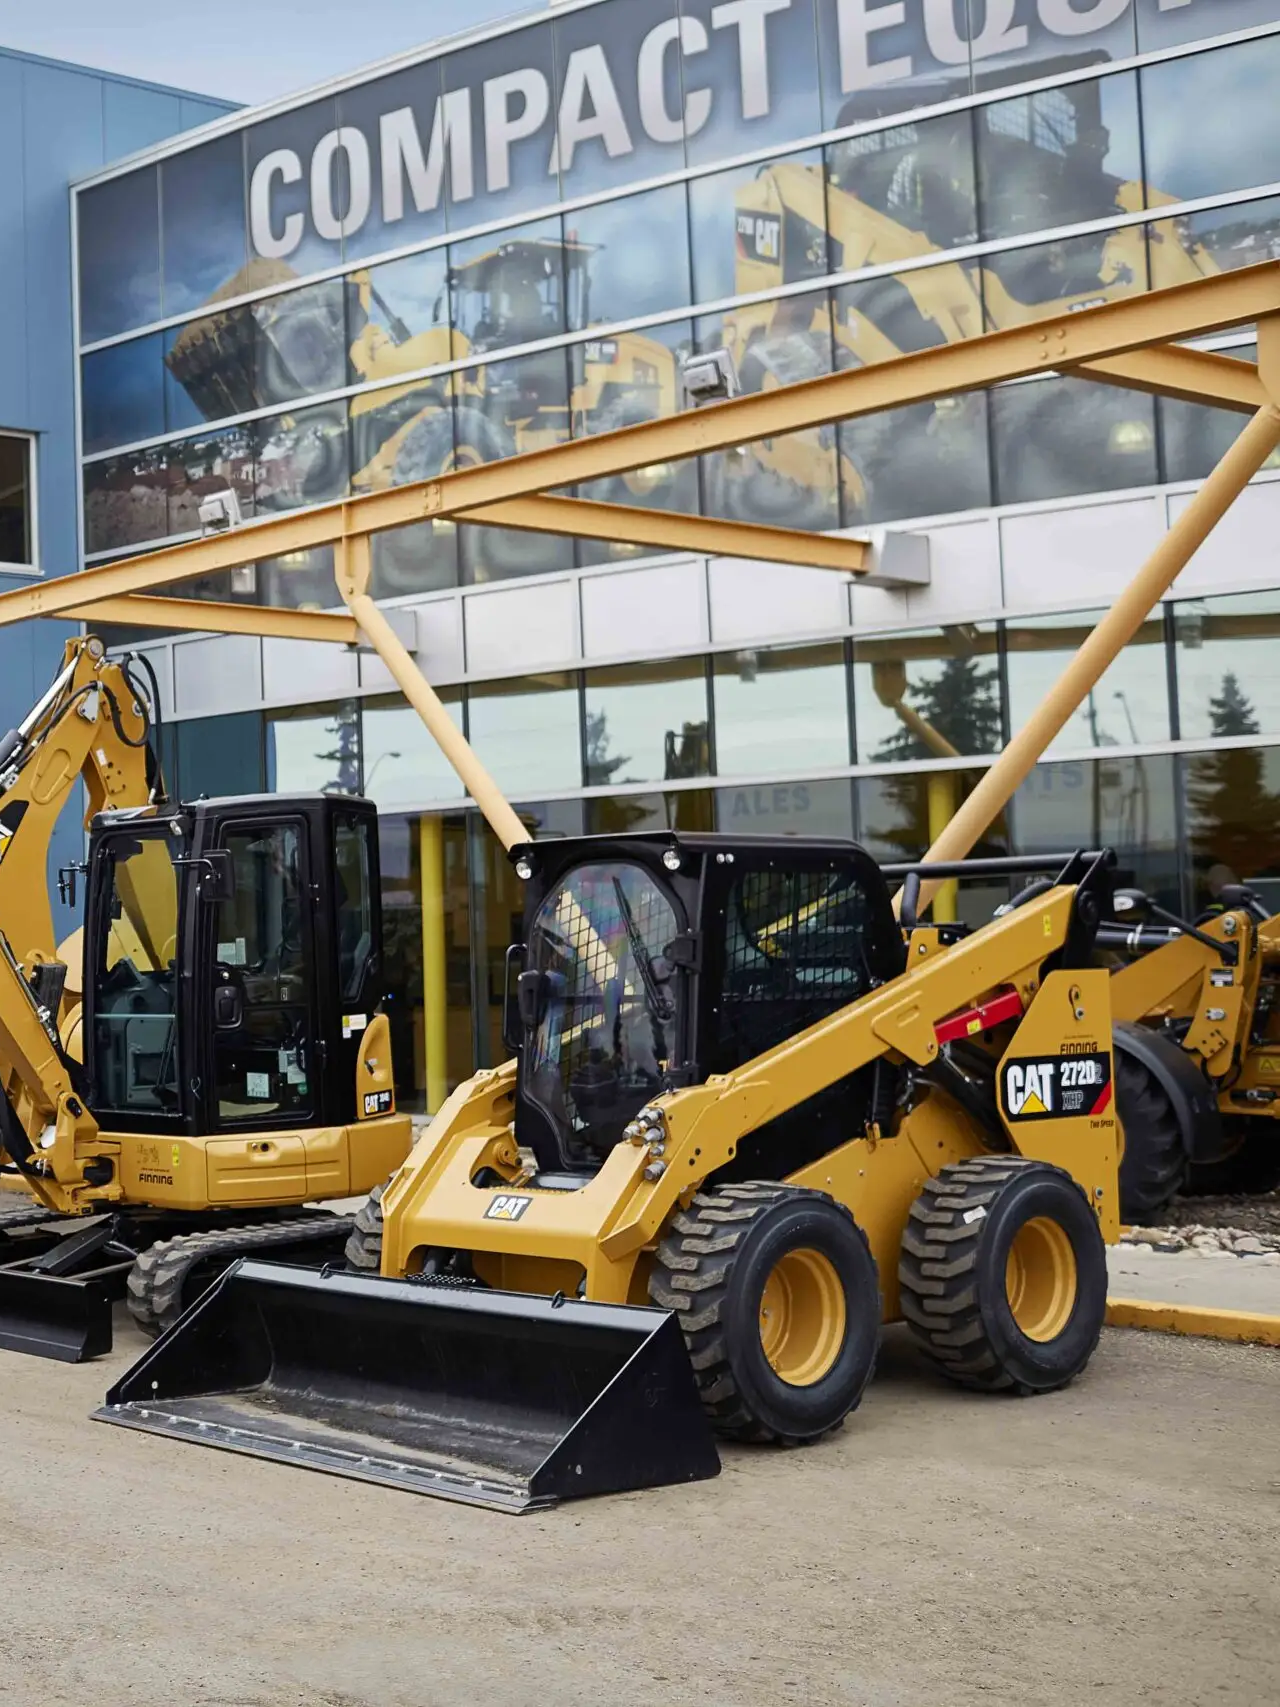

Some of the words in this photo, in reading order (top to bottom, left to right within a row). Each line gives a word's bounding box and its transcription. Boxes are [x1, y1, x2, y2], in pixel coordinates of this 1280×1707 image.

[250, 0, 791, 259] COMPACT
[755, 218, 779, 258] CAT
[365, 1094, 379, 1114] CAT
[1007, 1063, 1054, 1115] CAT
[139, 1173, 174, 1186] FINNING
[487, 1196, 529, 1219] CAT
